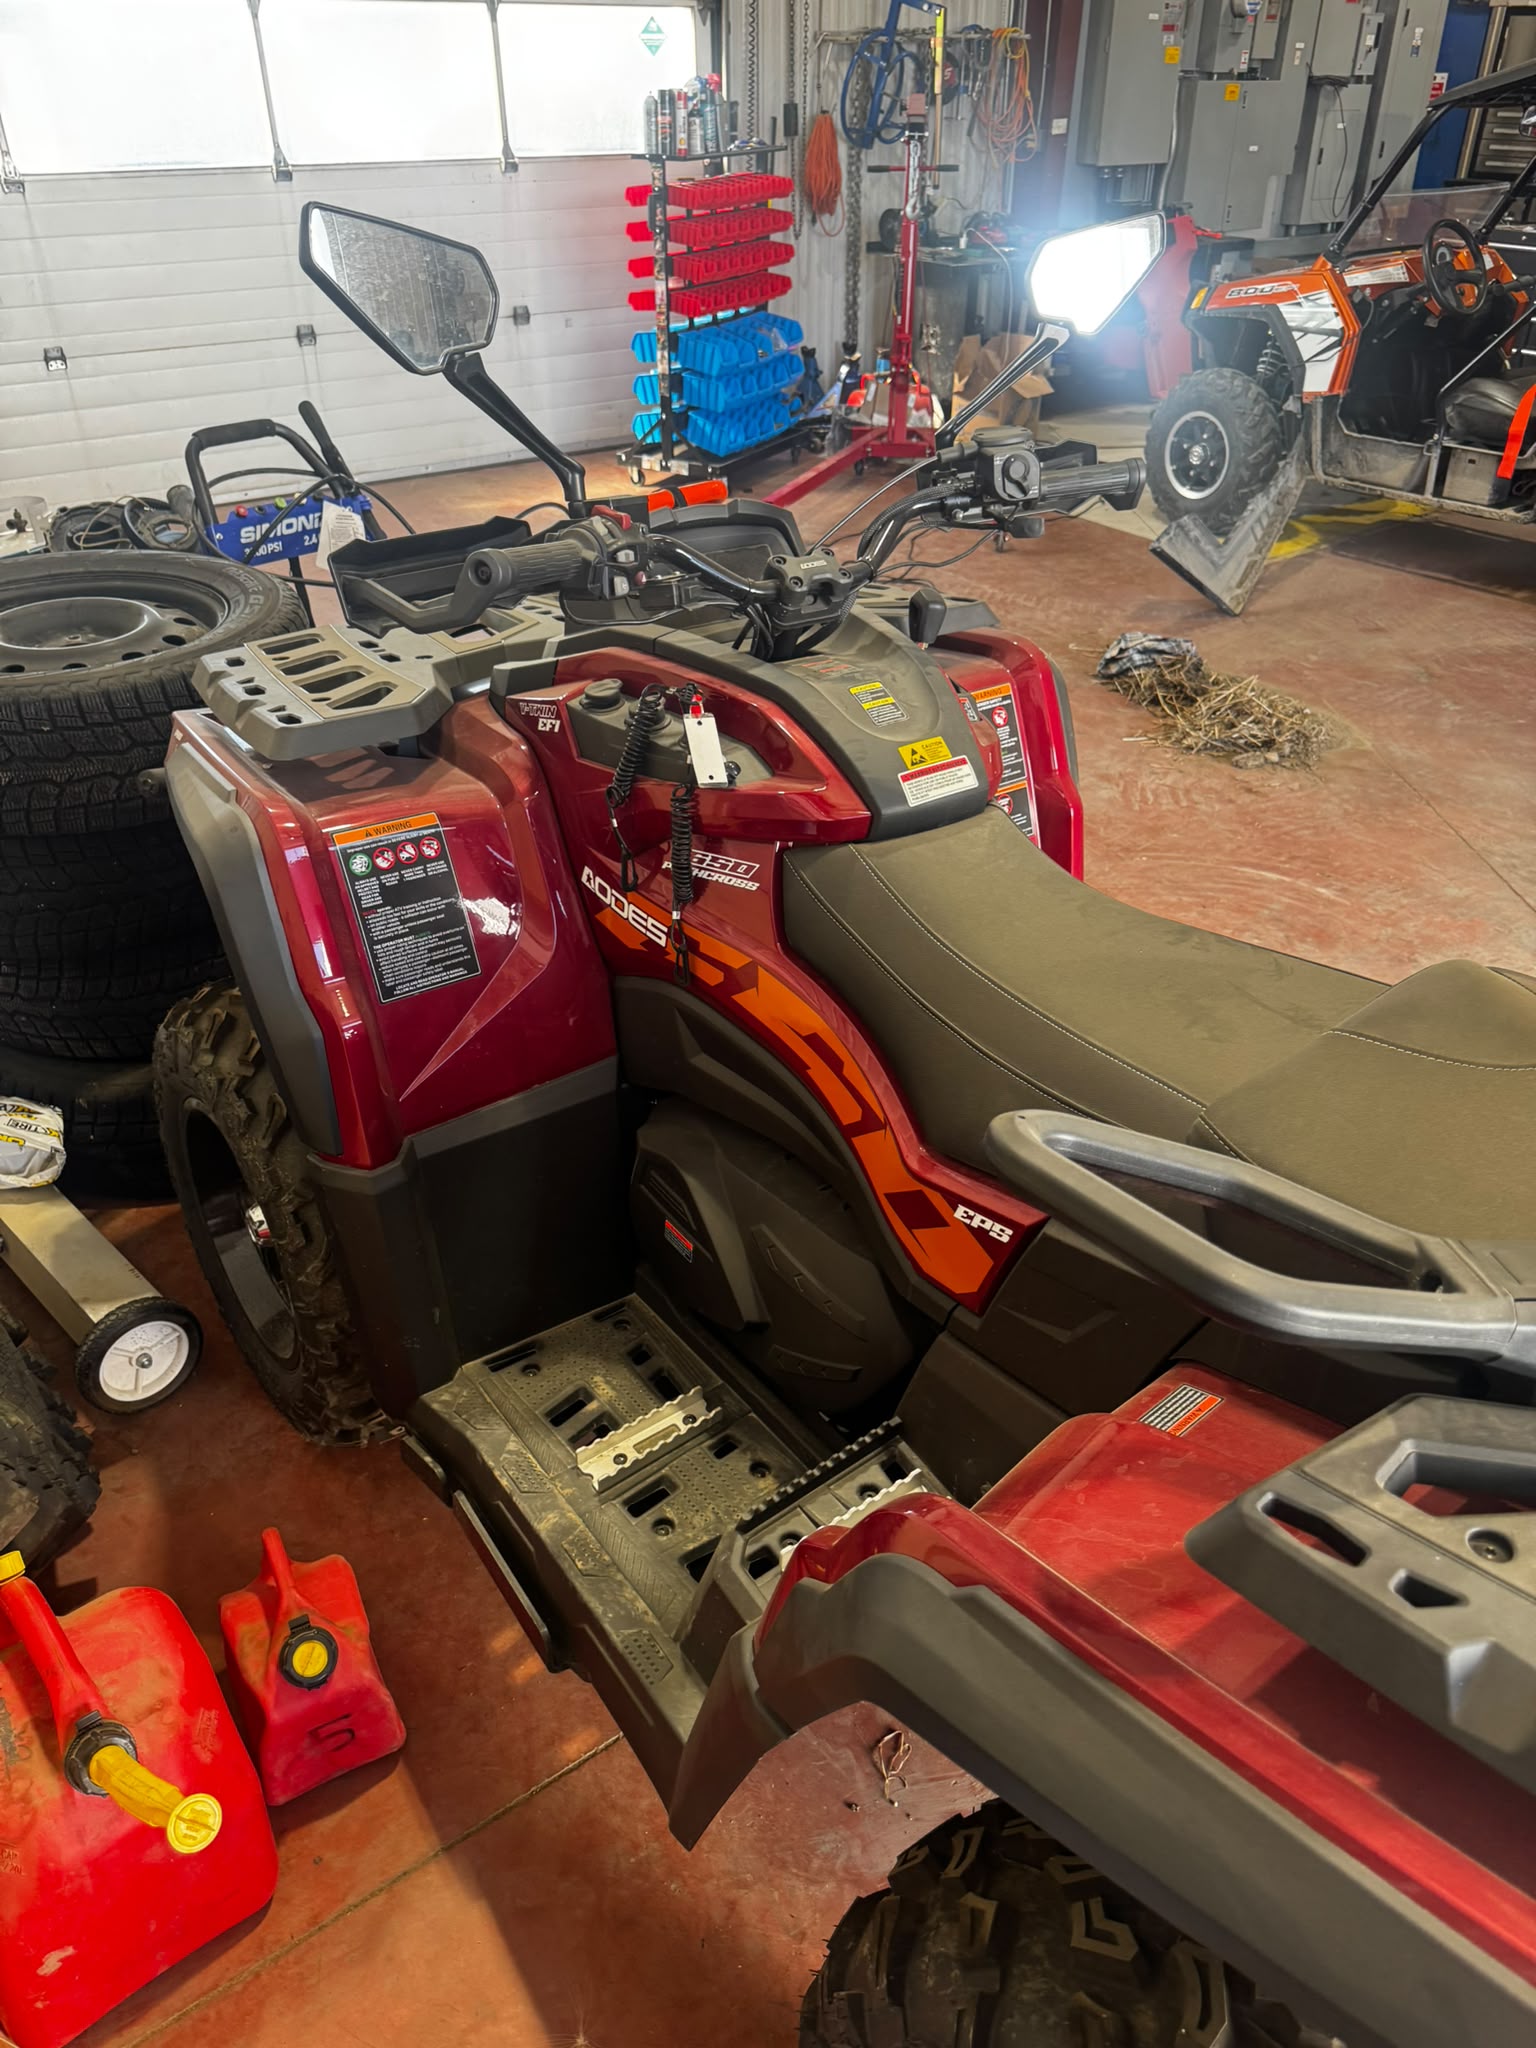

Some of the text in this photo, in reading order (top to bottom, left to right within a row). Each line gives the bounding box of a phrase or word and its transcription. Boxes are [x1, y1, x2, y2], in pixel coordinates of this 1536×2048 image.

[267, 541, 283, 554] PSI
[519, 702, 558, 719] V-TWIN
[538, 718, 561, 733] EFI
[372, 821, 412, 835] WARNING
[953, 1204, 1014, 1244] EPS
[307, 1713, 356, 1753] 5
